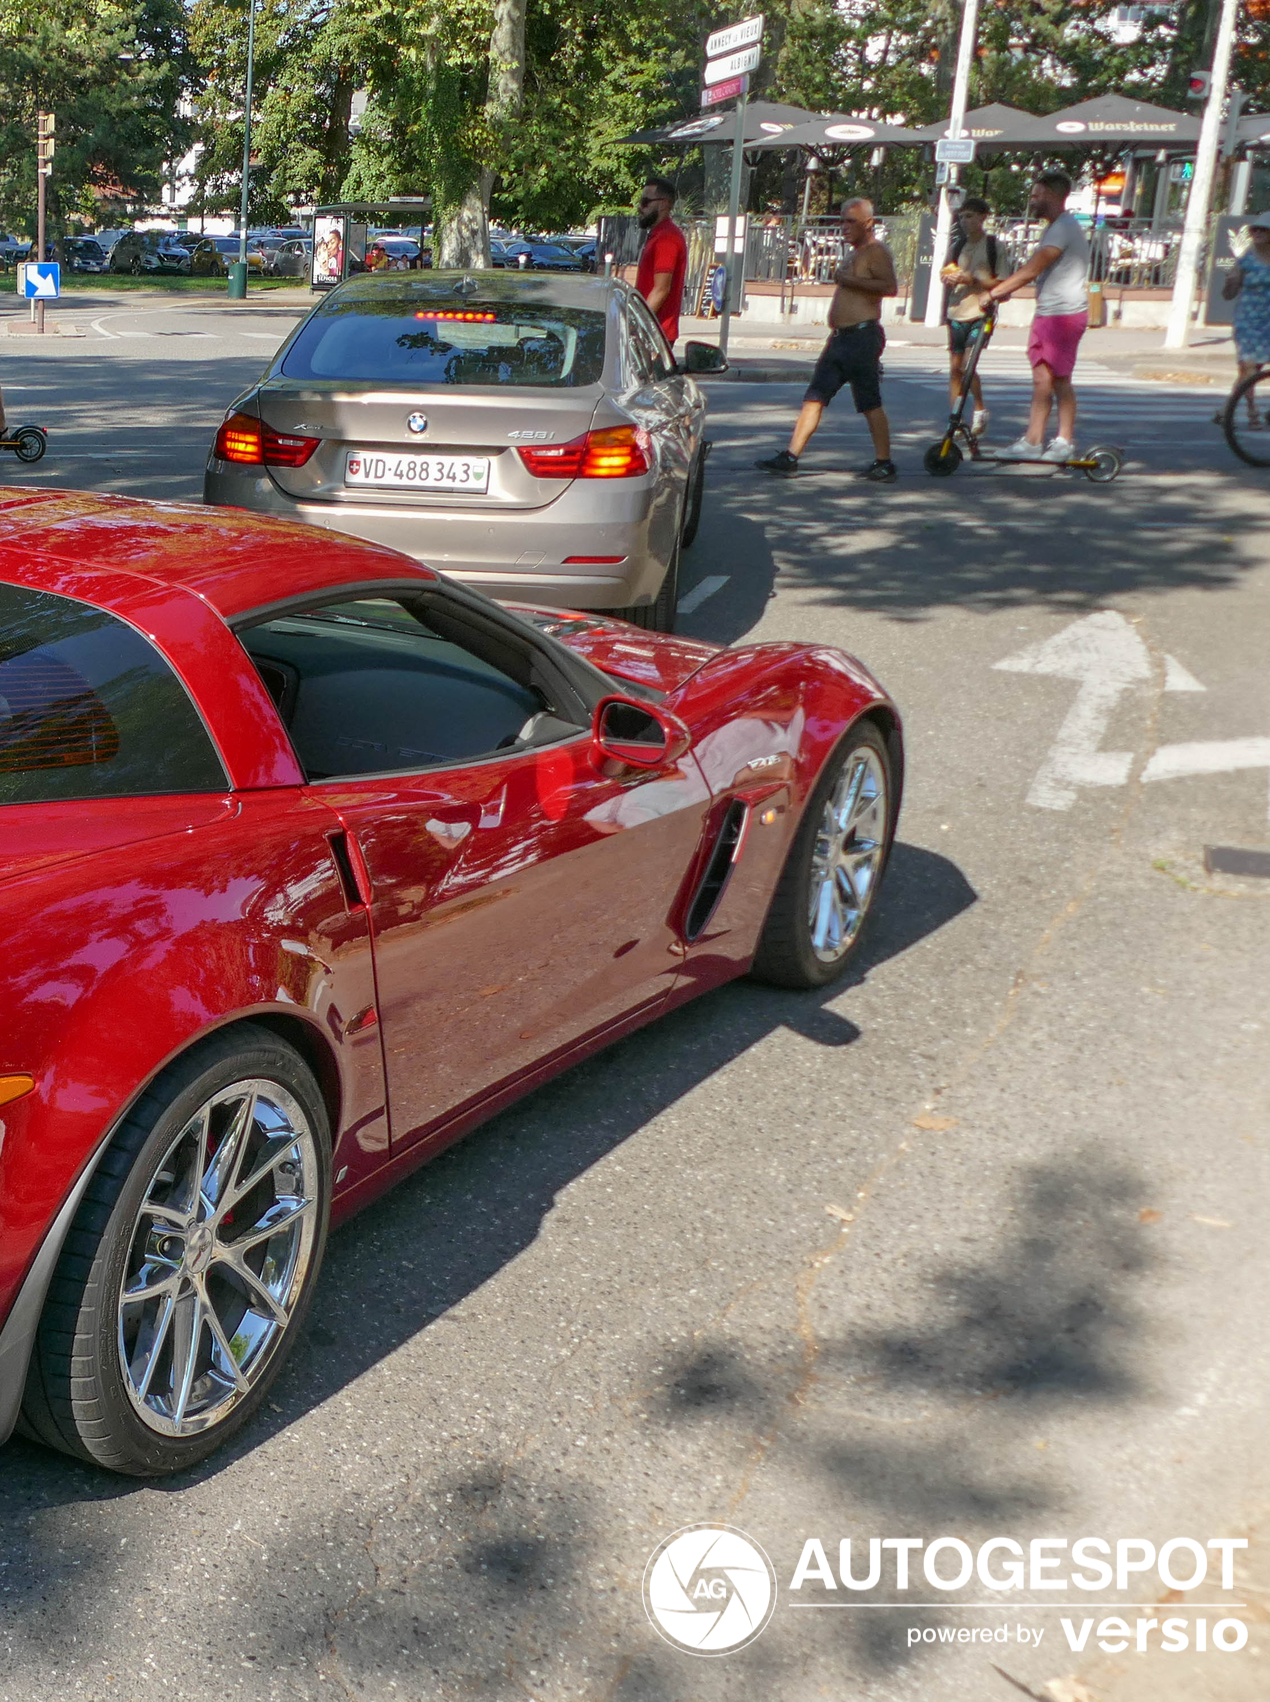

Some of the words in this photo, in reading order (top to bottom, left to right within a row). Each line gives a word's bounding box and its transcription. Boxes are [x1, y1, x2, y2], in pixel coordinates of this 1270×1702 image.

[710, 33, 732, 50] ANNECY
[740, 24, 758, 40] VIEUX
[730, 53, 756, 70] ALBIGNY
[1087, 120, 1177, 132] Warsteiner
[507, 430, 555, 439] 428i
